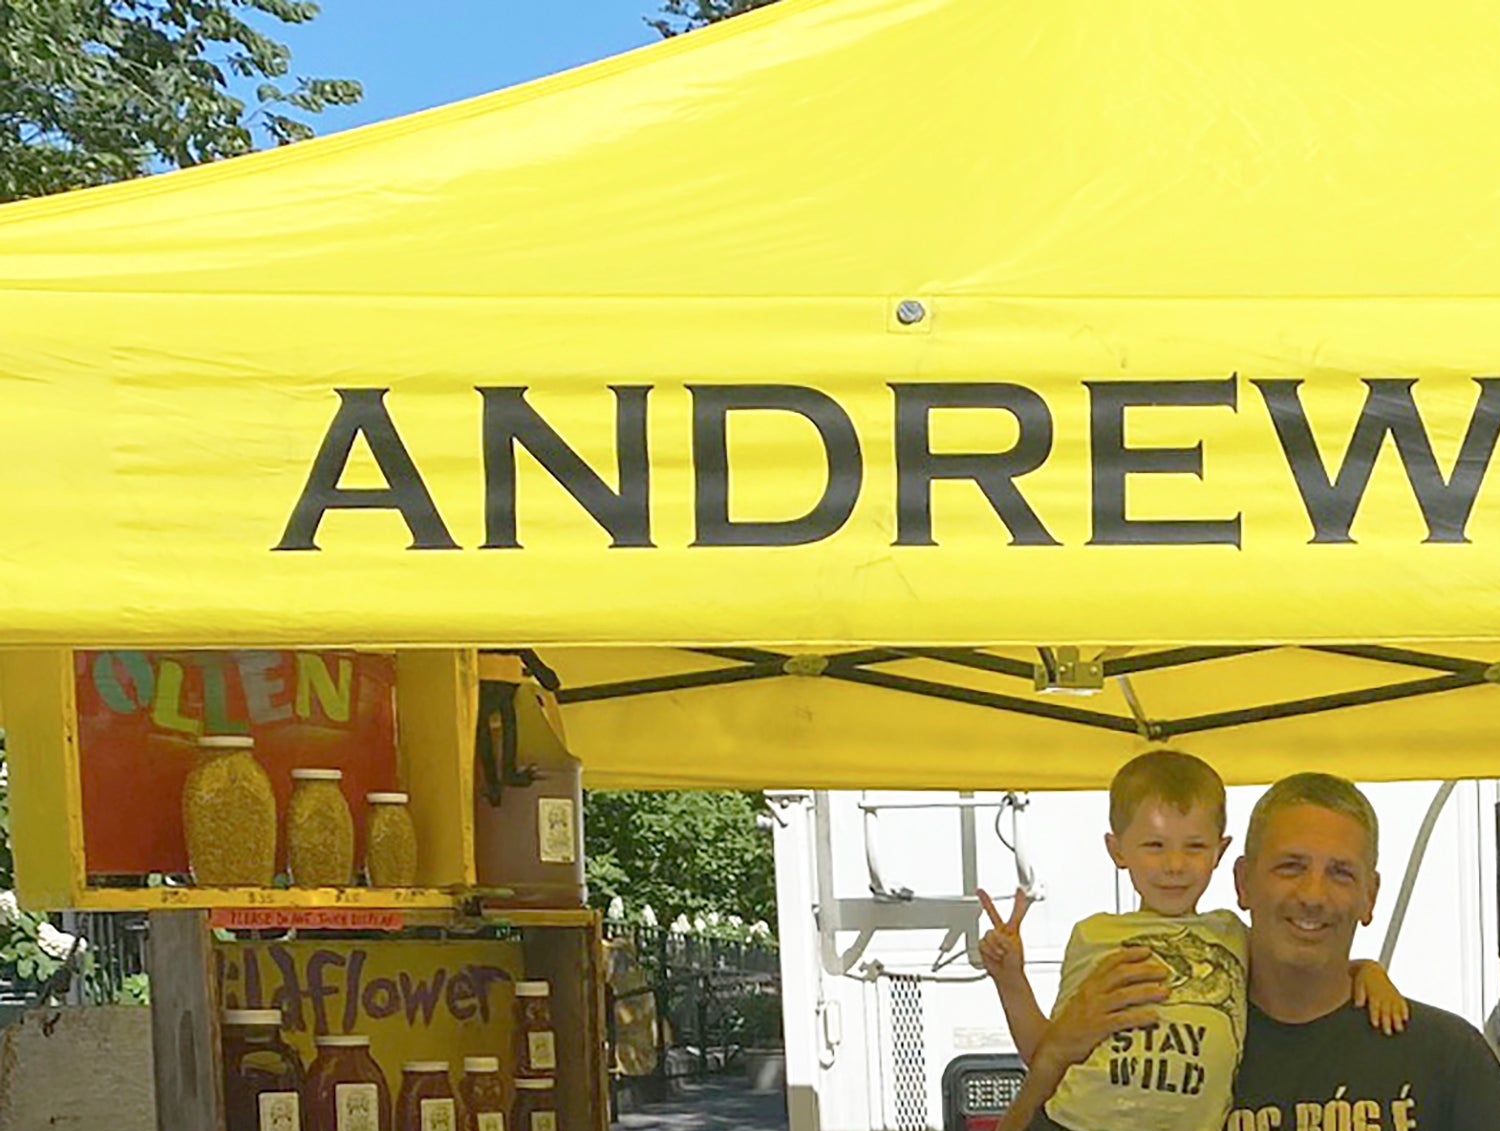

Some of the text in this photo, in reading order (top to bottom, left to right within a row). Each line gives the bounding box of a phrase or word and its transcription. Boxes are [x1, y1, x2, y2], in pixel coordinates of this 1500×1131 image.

[213, 942, 513, 1034] ildflower
[1109, 1023, 1207, 1057] STAY
[1109, 1058, 1206, 1095] WILD
